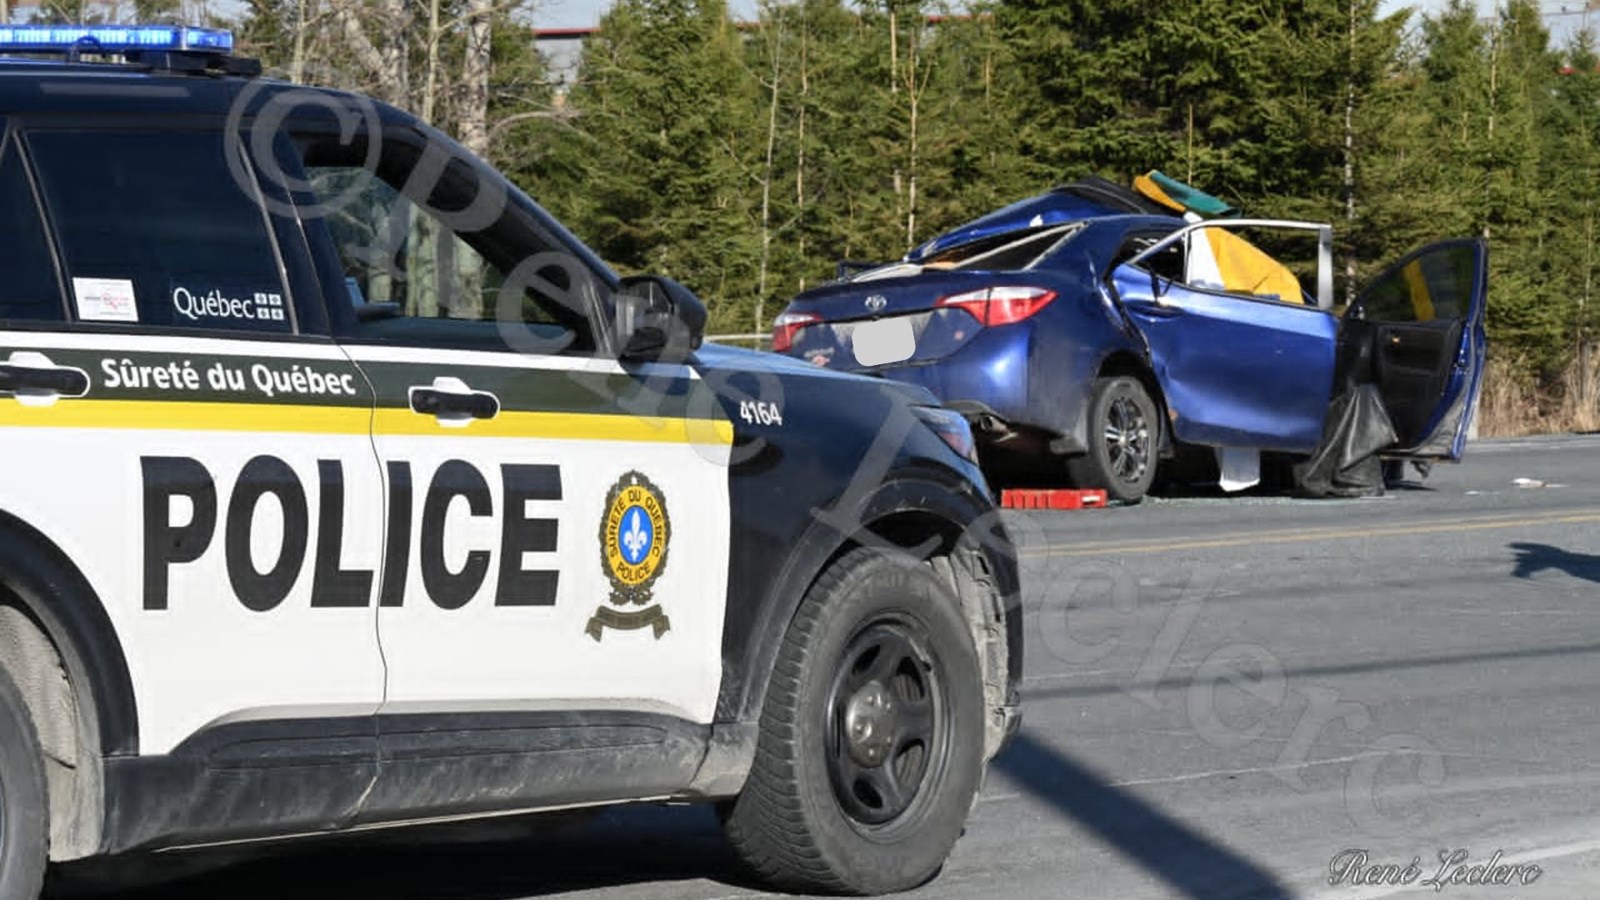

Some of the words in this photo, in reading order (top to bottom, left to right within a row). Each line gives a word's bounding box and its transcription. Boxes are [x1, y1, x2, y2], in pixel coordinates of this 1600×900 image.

[173, 286, 254, 320] Québec
[101, 358, 199, 391] Sûreté
[207, 363, 245, 391] du
[252, 363, 356, 397] Québec
[740, 400, 783, 426] 4164
[628, 489, 641, 502] DU
[140, 454, 563, 612] POLICE
[616, 561, 651, 582] POLICE
